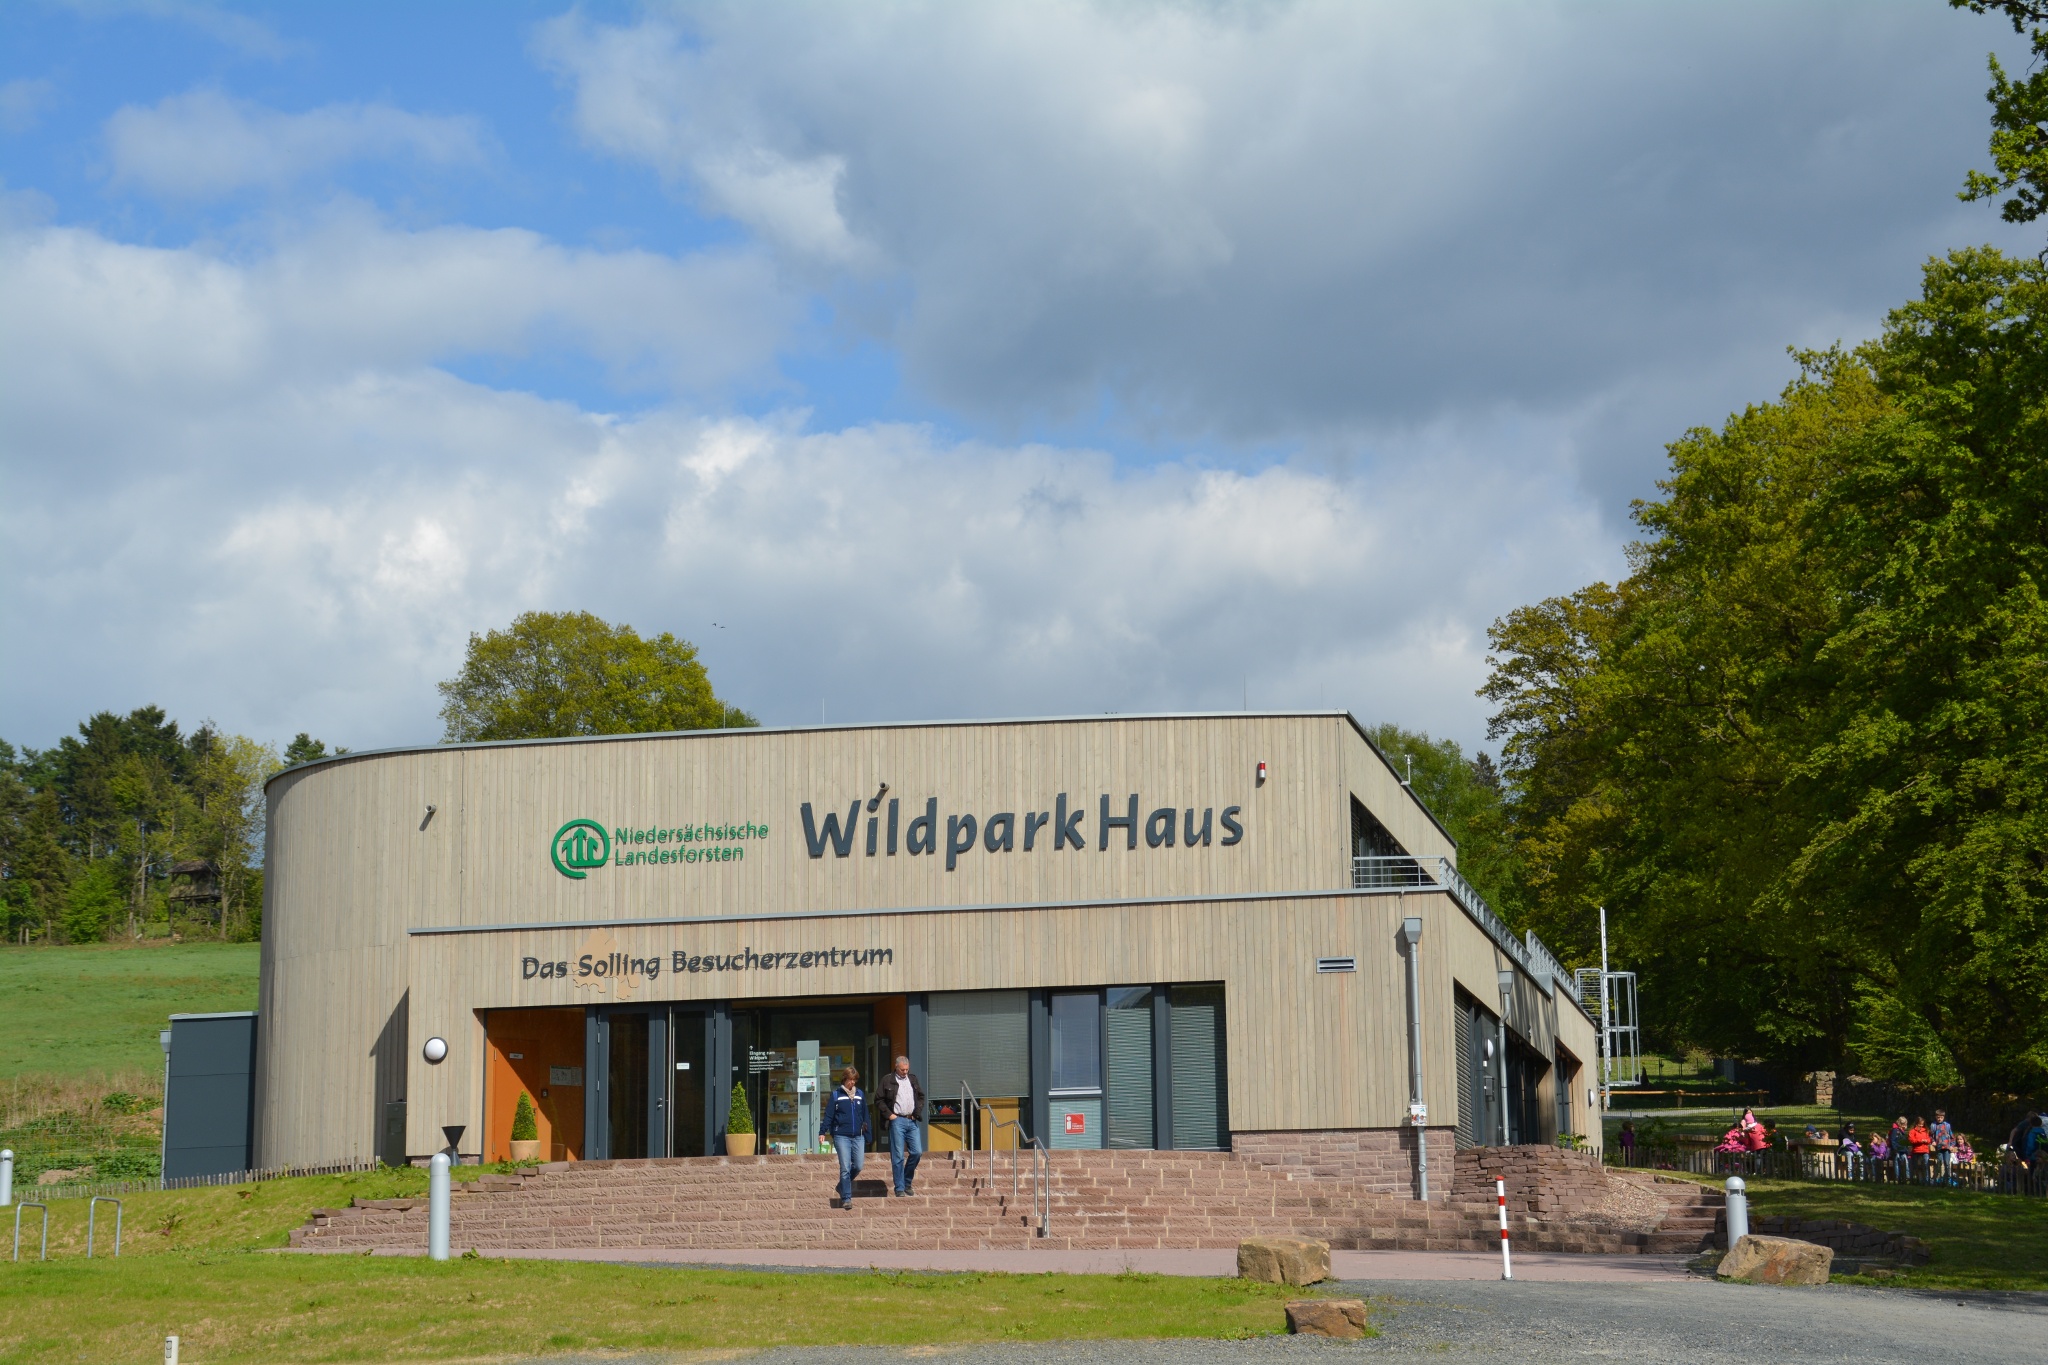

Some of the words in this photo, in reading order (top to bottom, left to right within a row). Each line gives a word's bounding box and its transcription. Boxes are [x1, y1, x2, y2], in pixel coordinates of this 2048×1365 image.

[615, 821, 769, 845] Niedersächsische
[615, 845, 744, 866] Landesforsten
[522, 957, 568, 979] Das
[578, 953, 660, 980] Solling
[672, 947, 893, 974] Besucherzentrum
